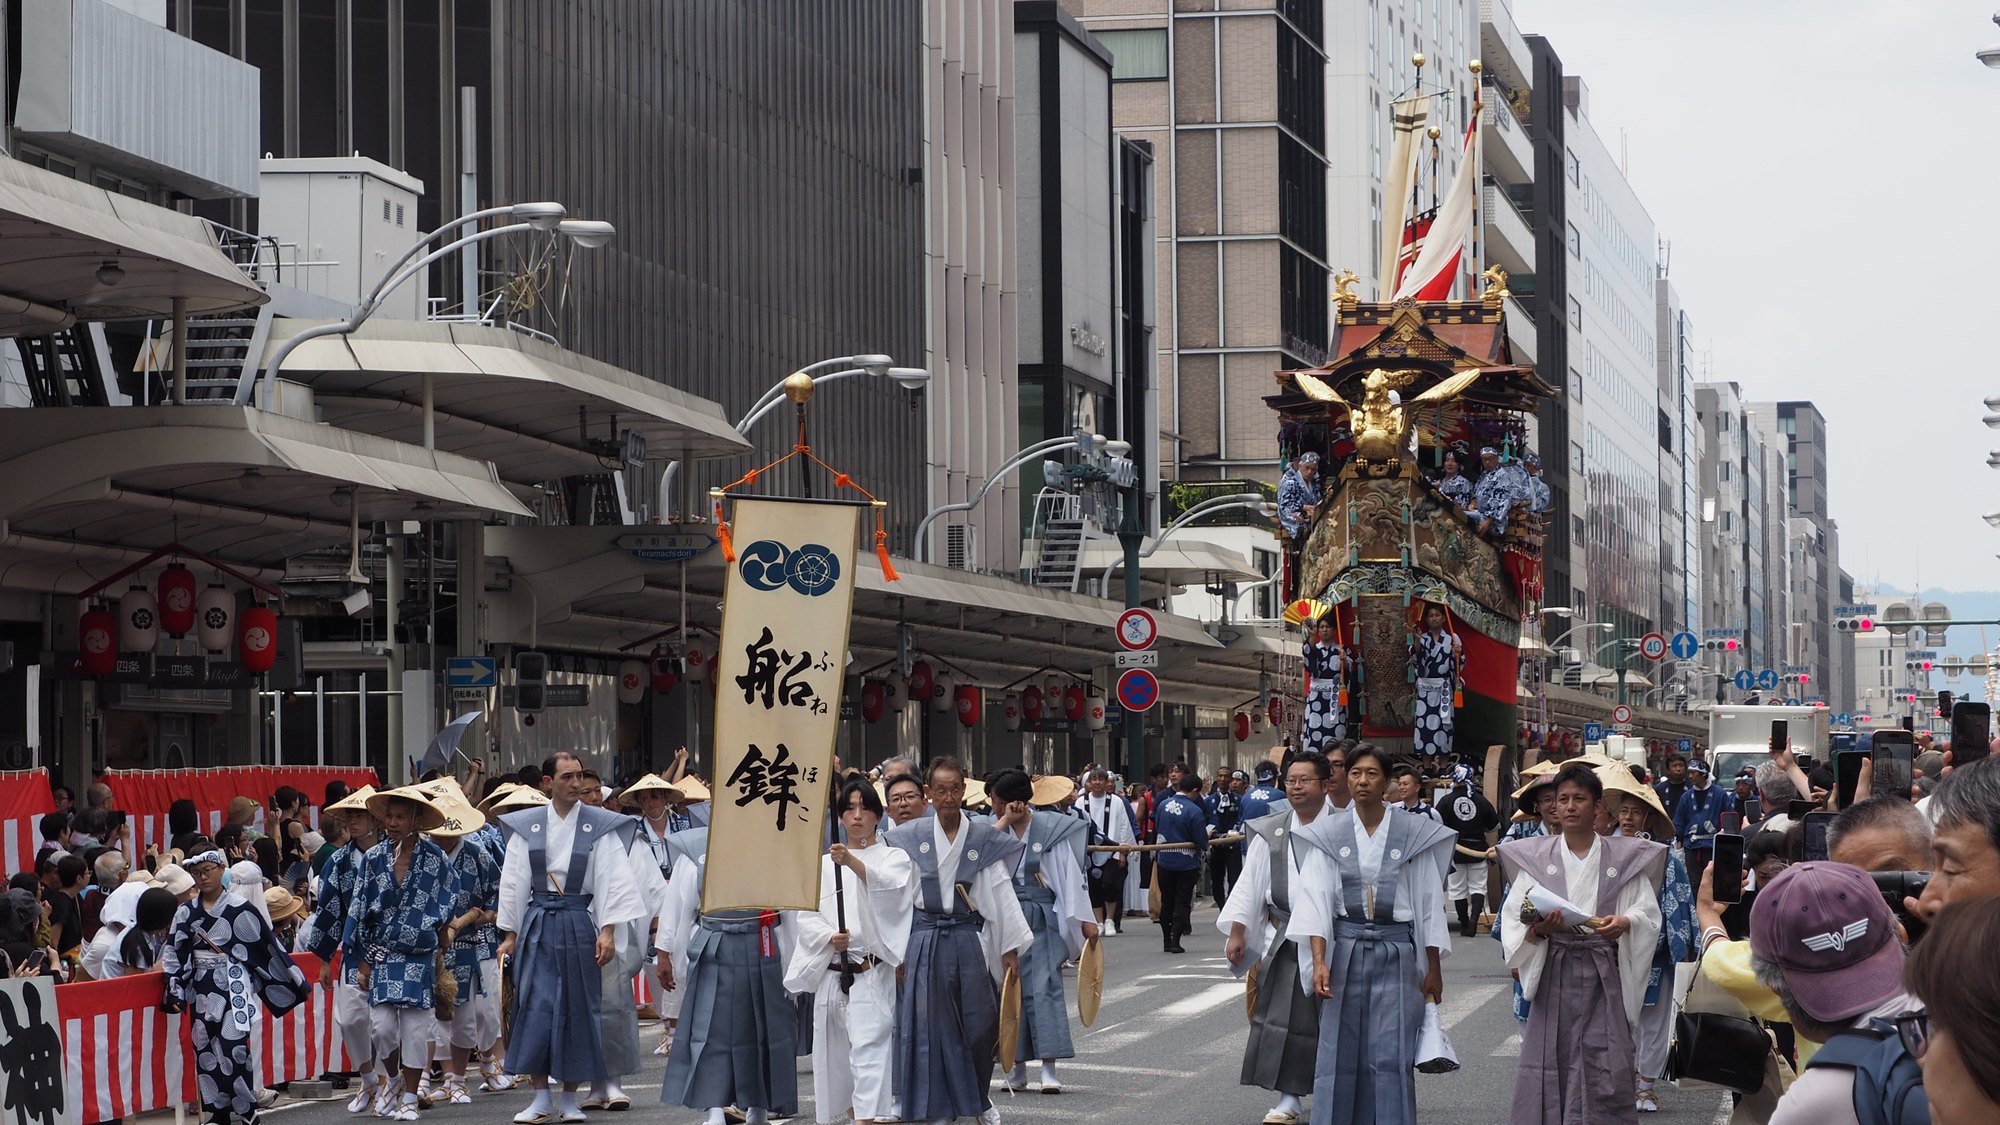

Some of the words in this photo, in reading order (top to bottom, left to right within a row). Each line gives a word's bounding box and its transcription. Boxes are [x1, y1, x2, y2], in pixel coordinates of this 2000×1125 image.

[1647, 641, 1661, 652] 40
[117, 661, 140, 672] 四条
[171, 664, 194, 677] 四条
